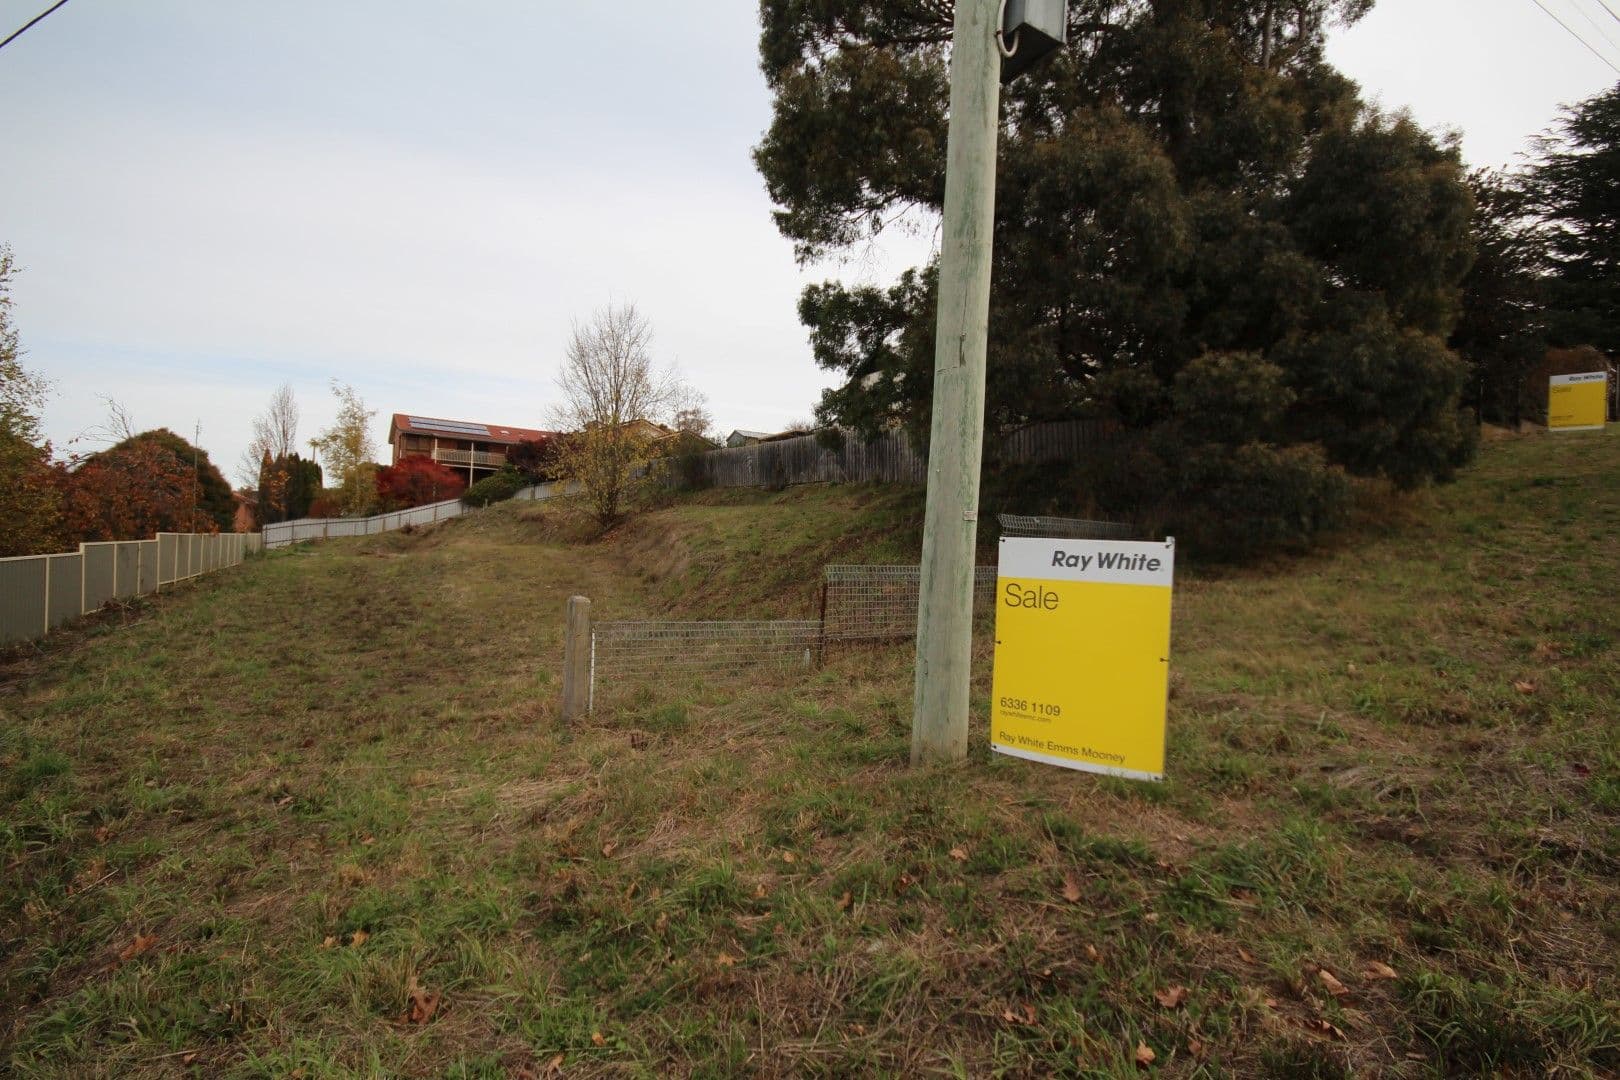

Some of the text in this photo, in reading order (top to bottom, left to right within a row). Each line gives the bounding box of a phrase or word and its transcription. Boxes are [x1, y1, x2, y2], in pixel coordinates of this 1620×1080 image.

[1052, 550, 1161, 571] Ray White
[1005, 583, 1059, 610] Sale
[1000, 697, 1060, 716] 6336 1109
[1000, 731, 1126, 763] Ray White Emms Mooney
